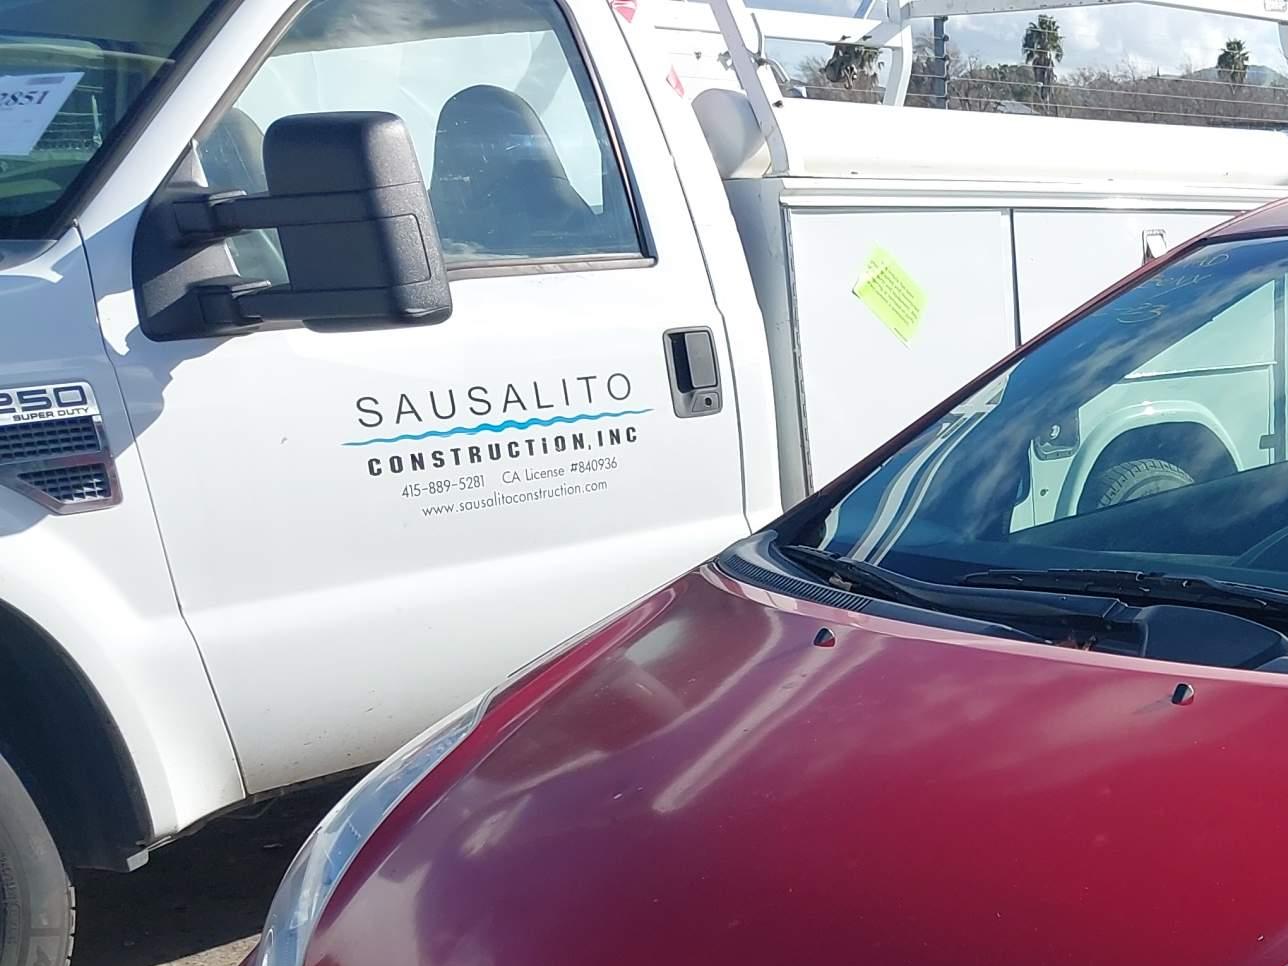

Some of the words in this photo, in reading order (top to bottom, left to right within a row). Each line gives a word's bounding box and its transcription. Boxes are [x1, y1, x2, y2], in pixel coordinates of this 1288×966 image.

[12, 410, 54, 422] SUPER
[57, 407, 89, 417] DUTY
[355, 372, 632, 428] SAUSALITO
[401, 474, 485, 499] 415-889-5281
[502, 470, 521, 484] CA
[525, 466, 565, 481] License
[570, 456, 618, 474] #840936
[422, 480, 608, 517] www.sausalitoconstruction.com
